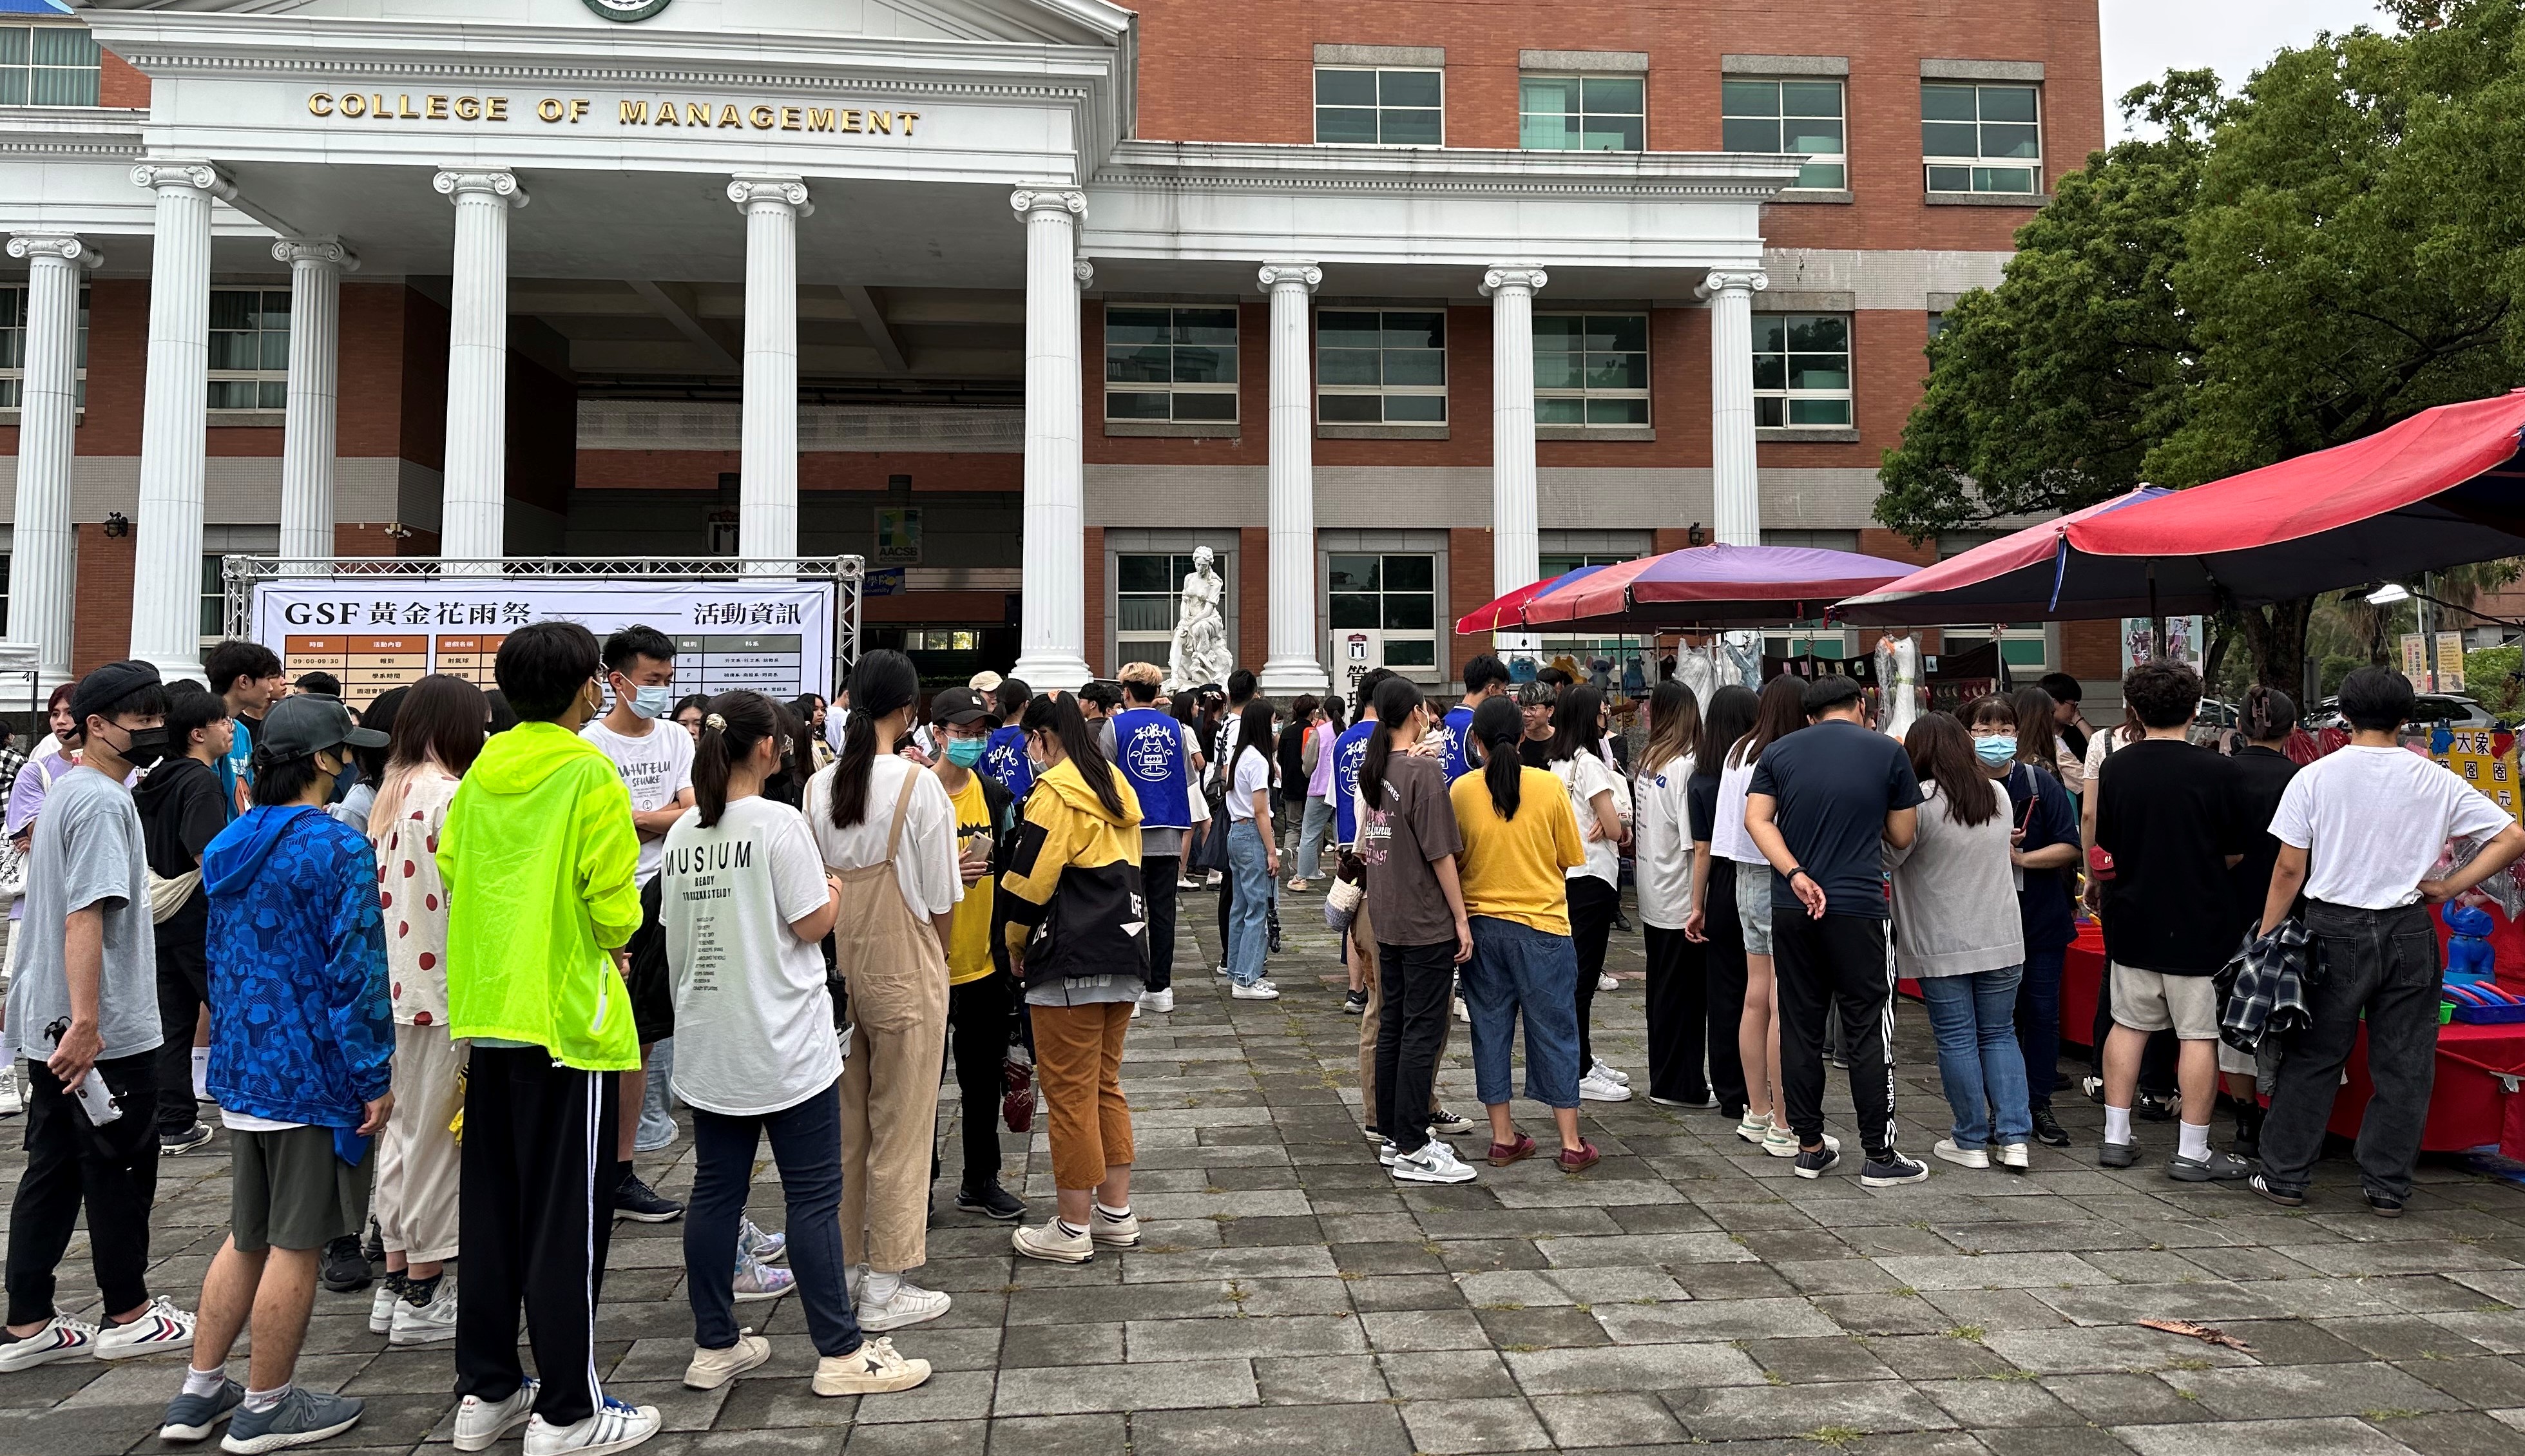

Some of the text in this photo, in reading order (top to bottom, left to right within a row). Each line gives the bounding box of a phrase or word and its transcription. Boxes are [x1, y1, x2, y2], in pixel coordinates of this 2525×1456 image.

[309, 92, 921, 136] COLLEGE OF MANAGEMENT
[879, 546, 918, 557] AACSB
[285, 601, 532, 625] GSF 黃金花雨祭
[694, 602, 802, 625] 活動資訊
[2457, 733, 2490, 754] 大象
[695, 876, 715, 887] READY
[1887, 1068, 1895, 1113] adidas
